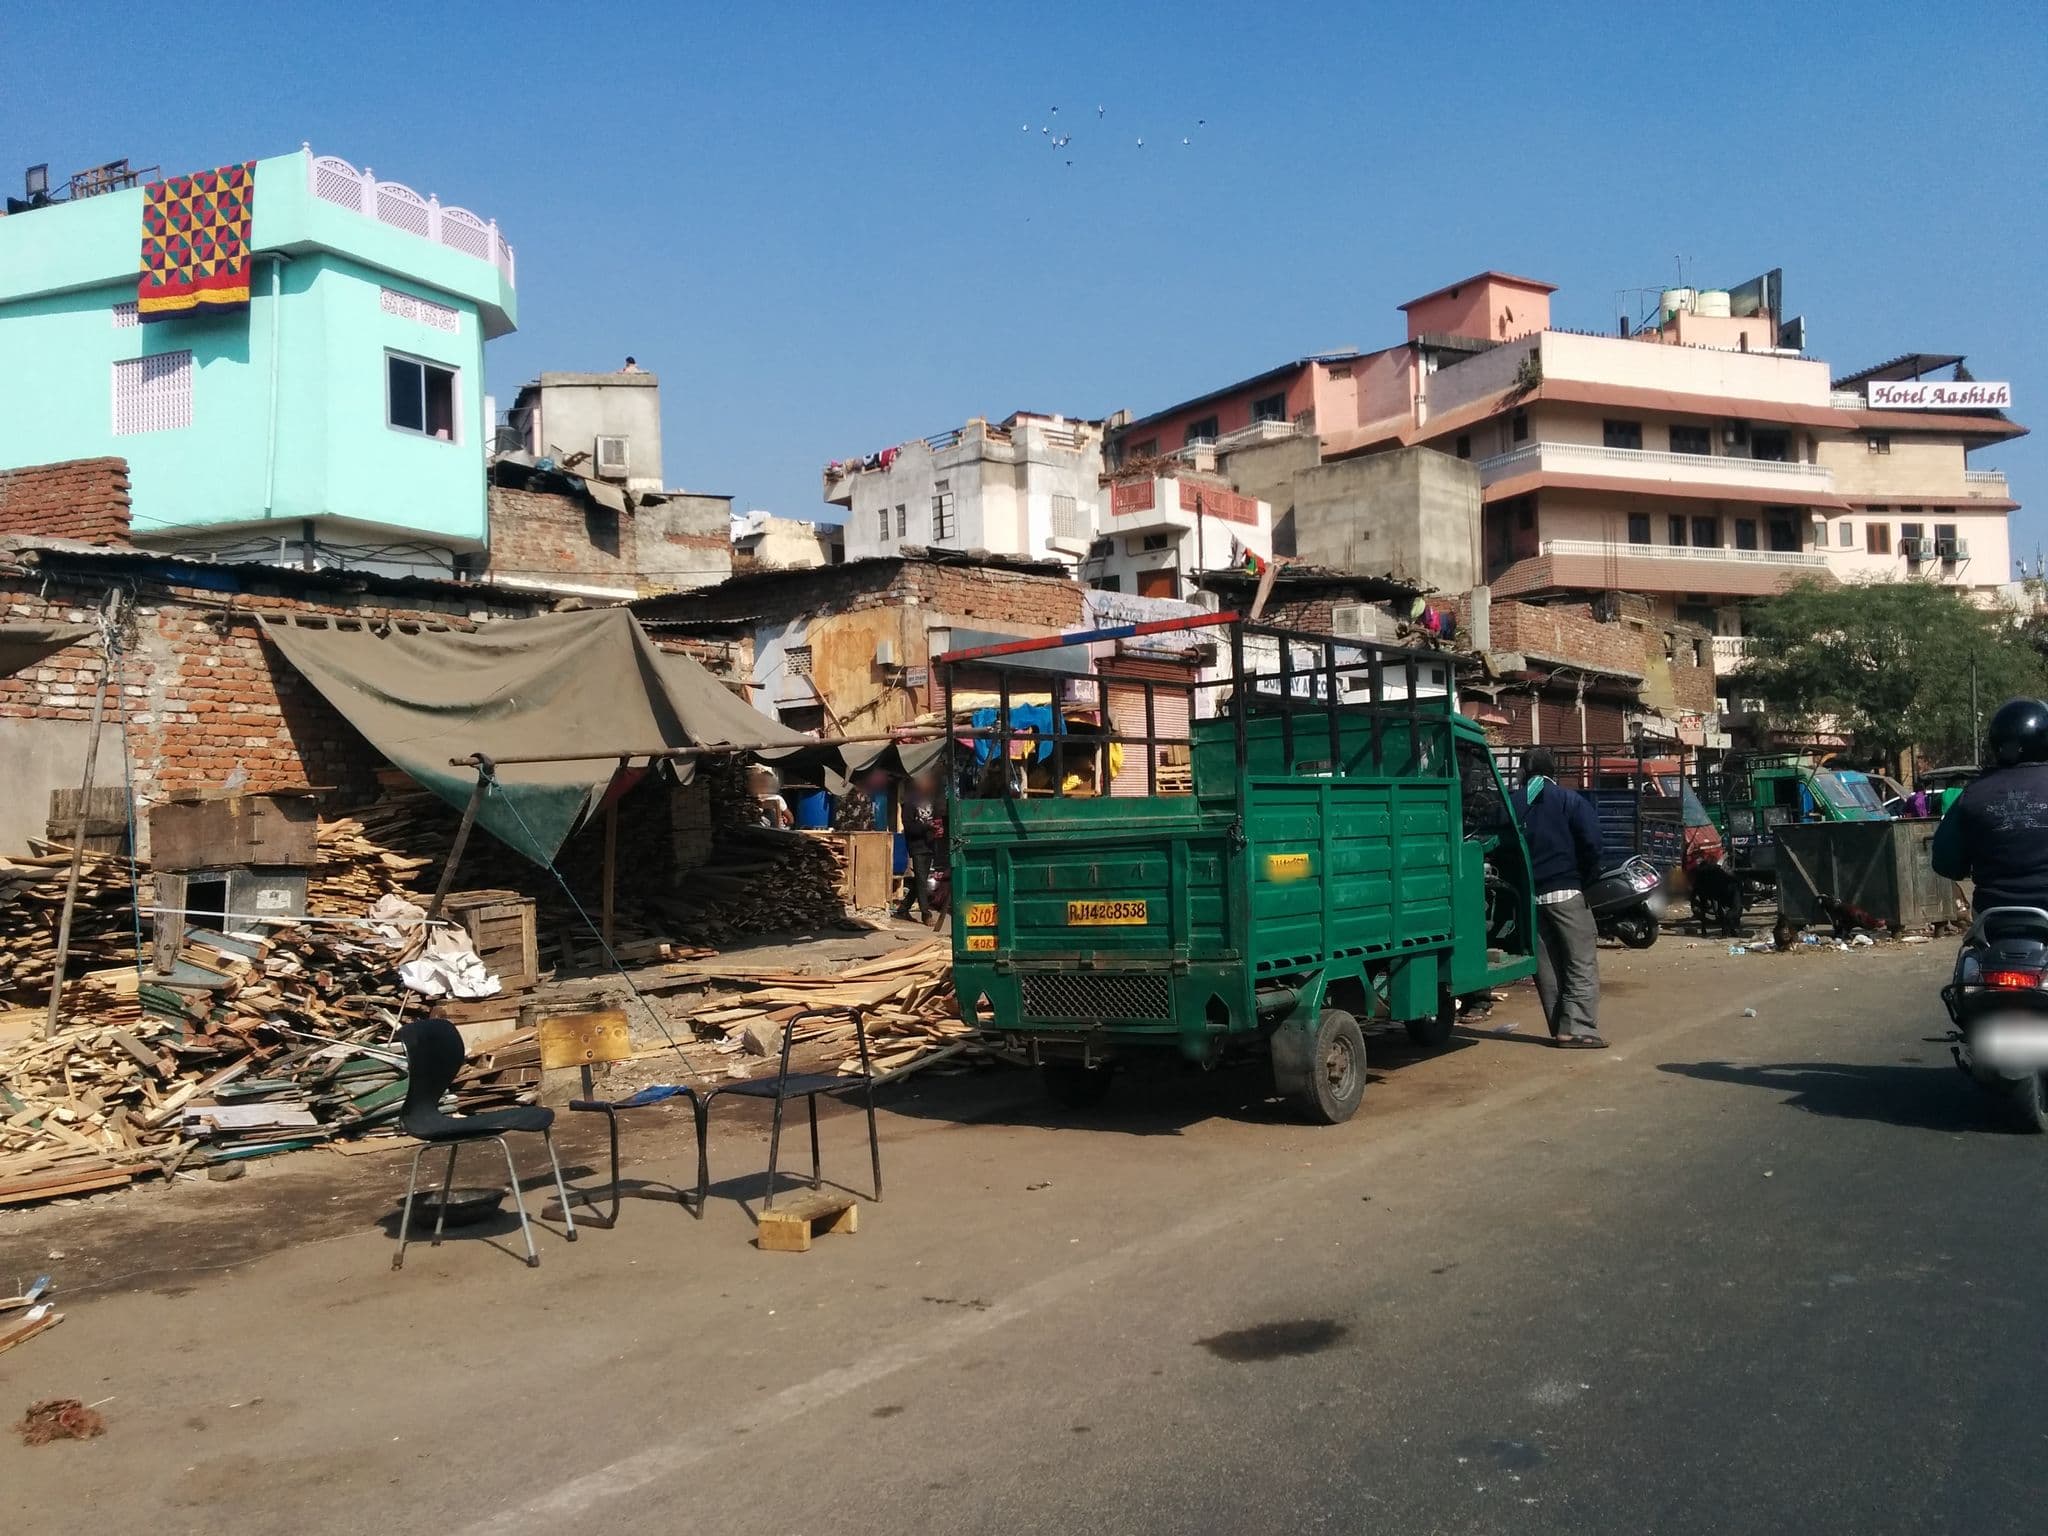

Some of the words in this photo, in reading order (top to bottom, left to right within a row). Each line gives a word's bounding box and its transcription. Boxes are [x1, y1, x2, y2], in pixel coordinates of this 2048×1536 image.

[1874, 386, 1928, 404] Hotel
[1930, 386, 2008, 404] Aashish
[1679, 715, 1702, 723] CAR
